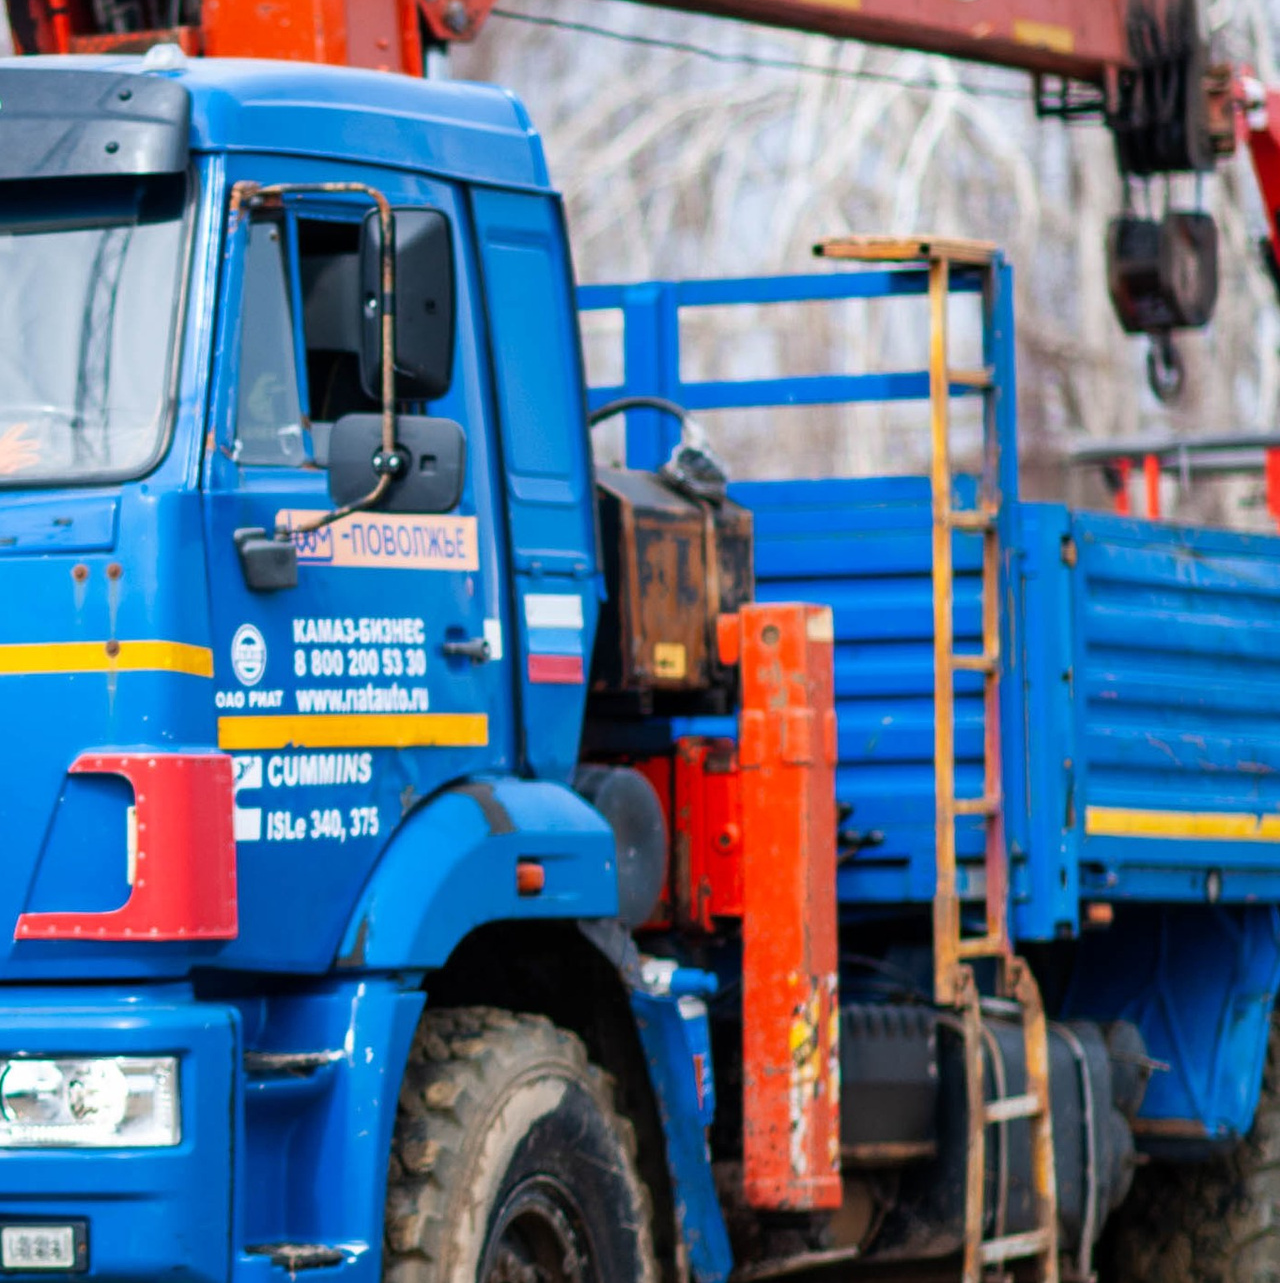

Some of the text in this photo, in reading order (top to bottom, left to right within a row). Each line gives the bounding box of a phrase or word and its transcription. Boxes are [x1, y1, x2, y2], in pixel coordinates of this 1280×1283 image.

[293, 618, 425, 644] КАМАЗ-БИЗНЕС
[294, 649, 306, 676] 8
[311, 649, 344, 676] 800
[347, 649, 379, 676] 200
[382, 648, 403, 676] 53
[215, 690, 283, 708] ОАО РИАТ
[267, 752, 372, 787] CUMMINS
[267, 806, 379, 843] ISLe 340, 375
